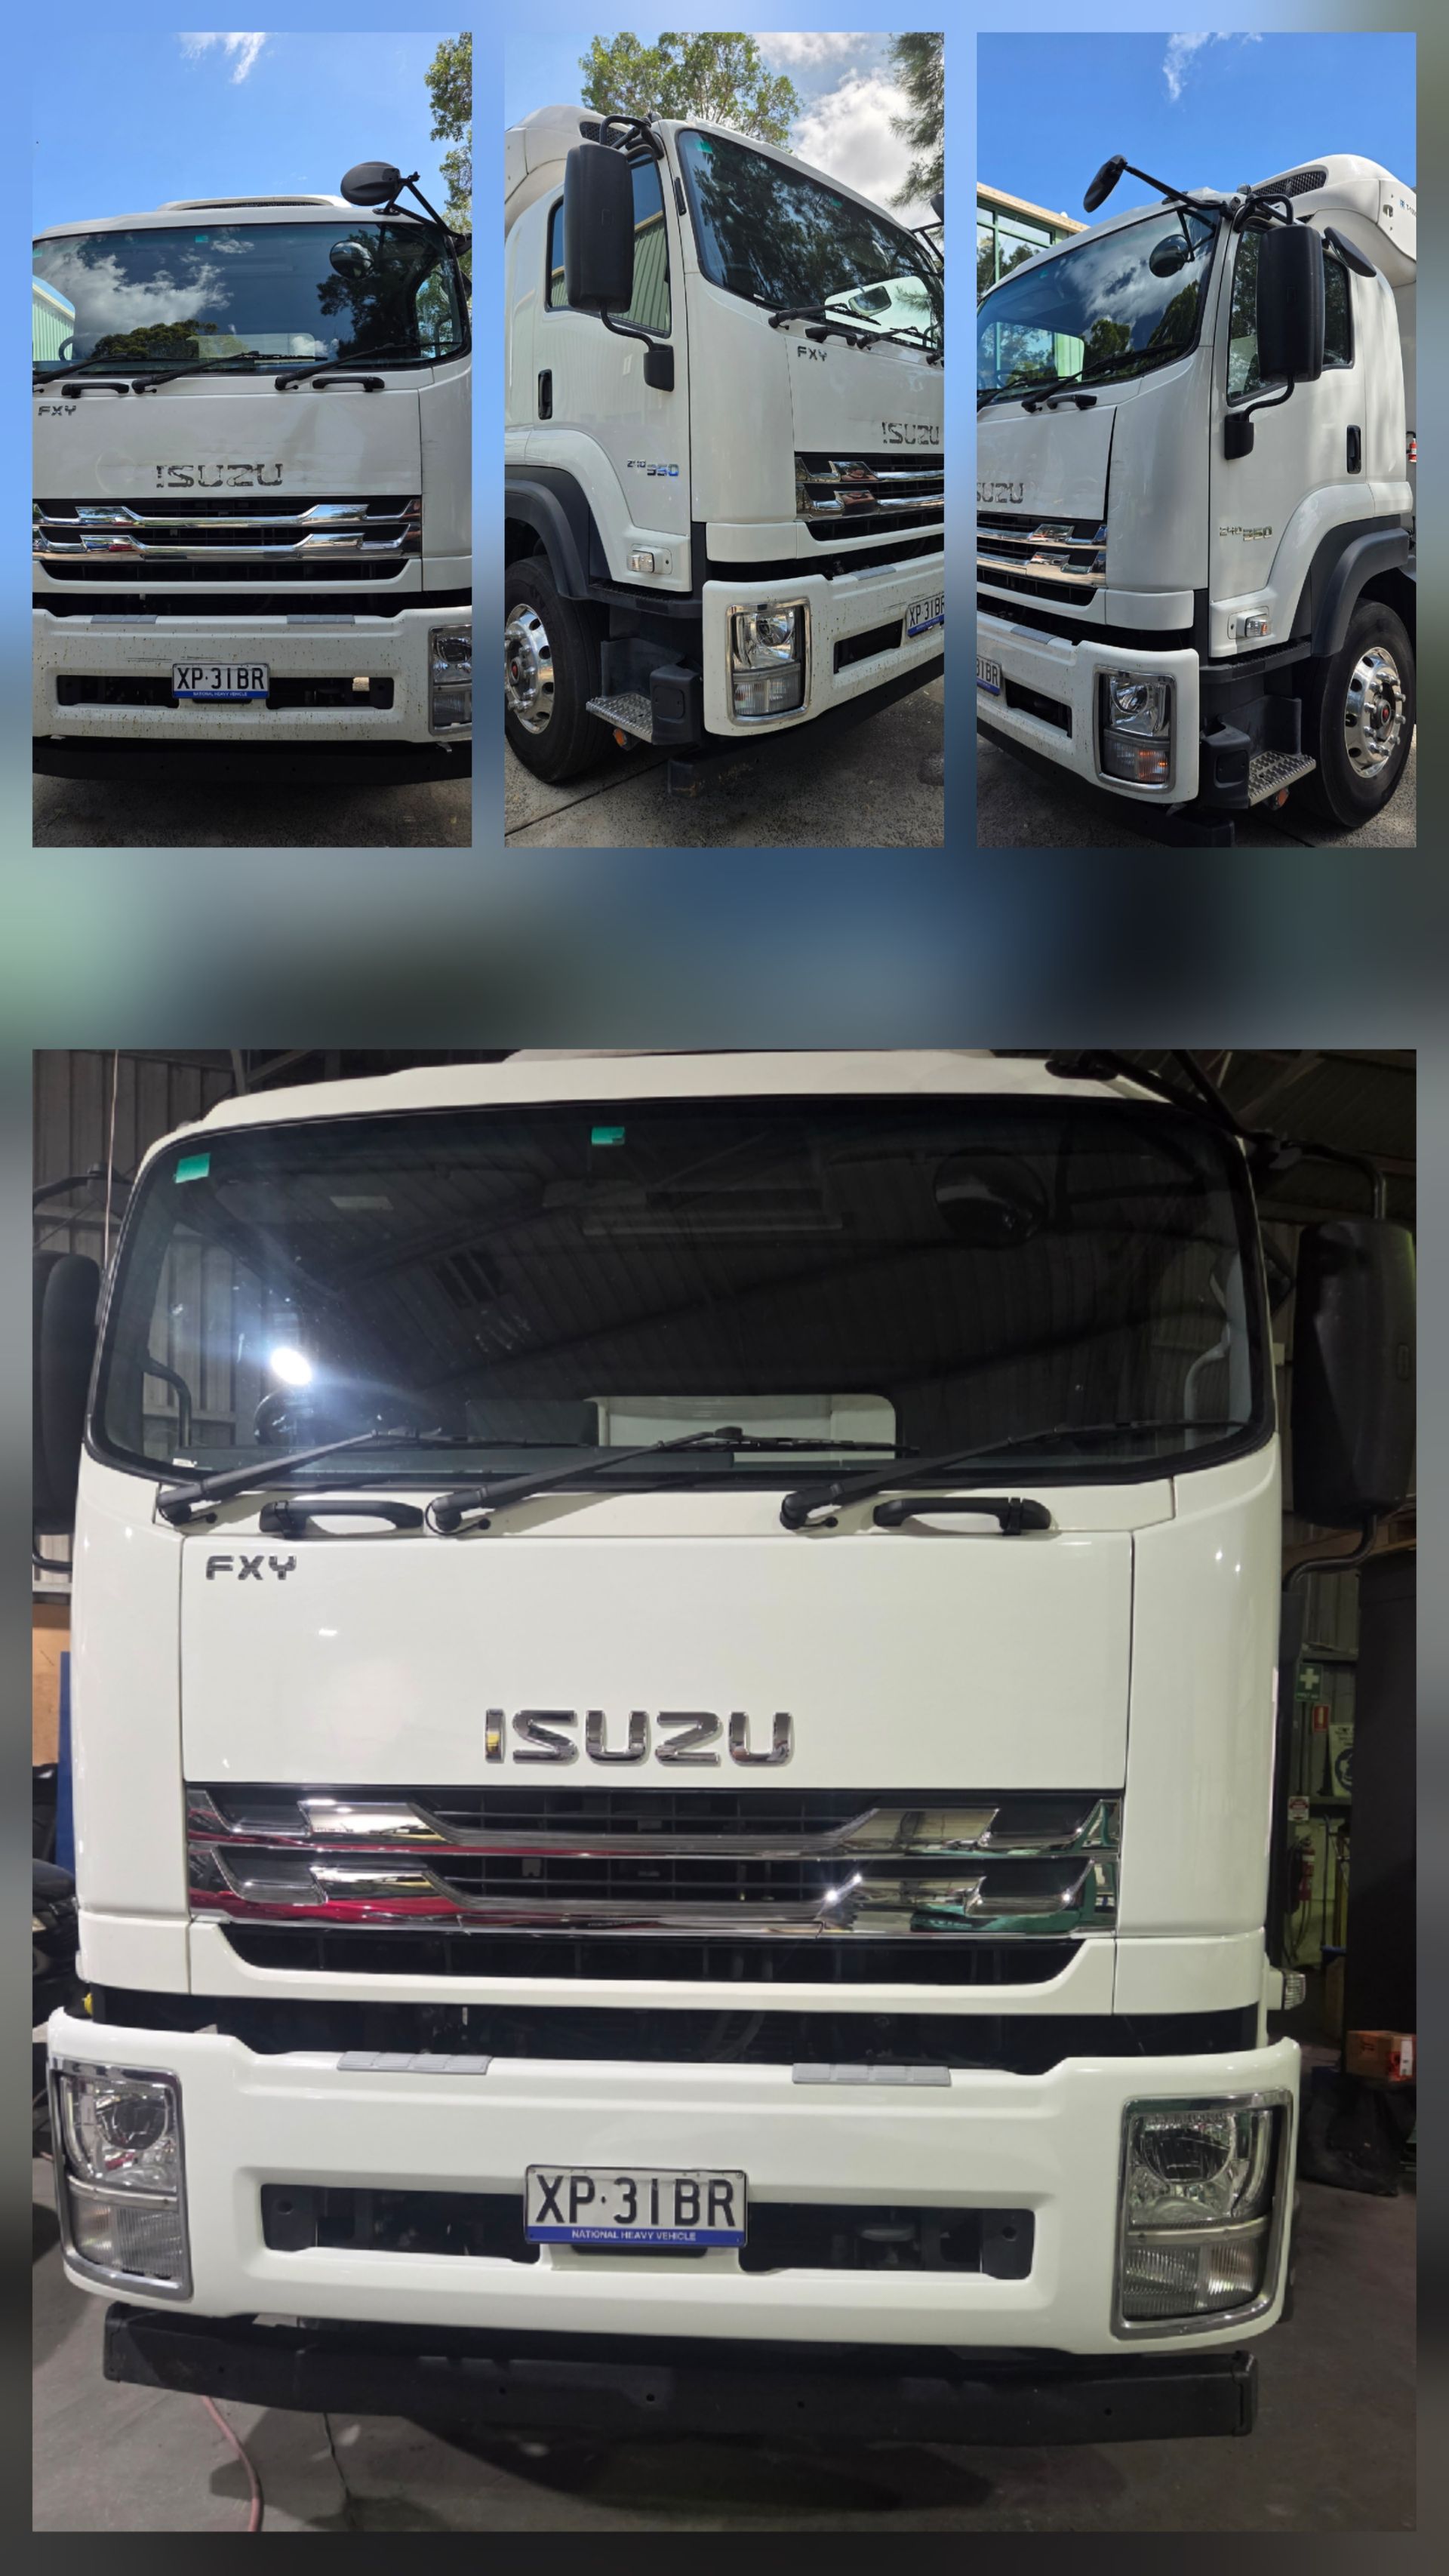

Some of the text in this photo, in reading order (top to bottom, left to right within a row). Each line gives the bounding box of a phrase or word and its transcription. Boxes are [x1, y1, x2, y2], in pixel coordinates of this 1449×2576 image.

[797, 346, 827, 362] FXY
[38, 405, 77, 416] FXY
[881, 421, 940, 445] ISUZU
[156, 463, 283, 488] ISUZU
[205, 1555, 297, 1580] FXY
[485, 1709, 792, 1767] ISUZU
[572, 2229, 697, 2242] NATIONAL HEAVY VEHICLE
